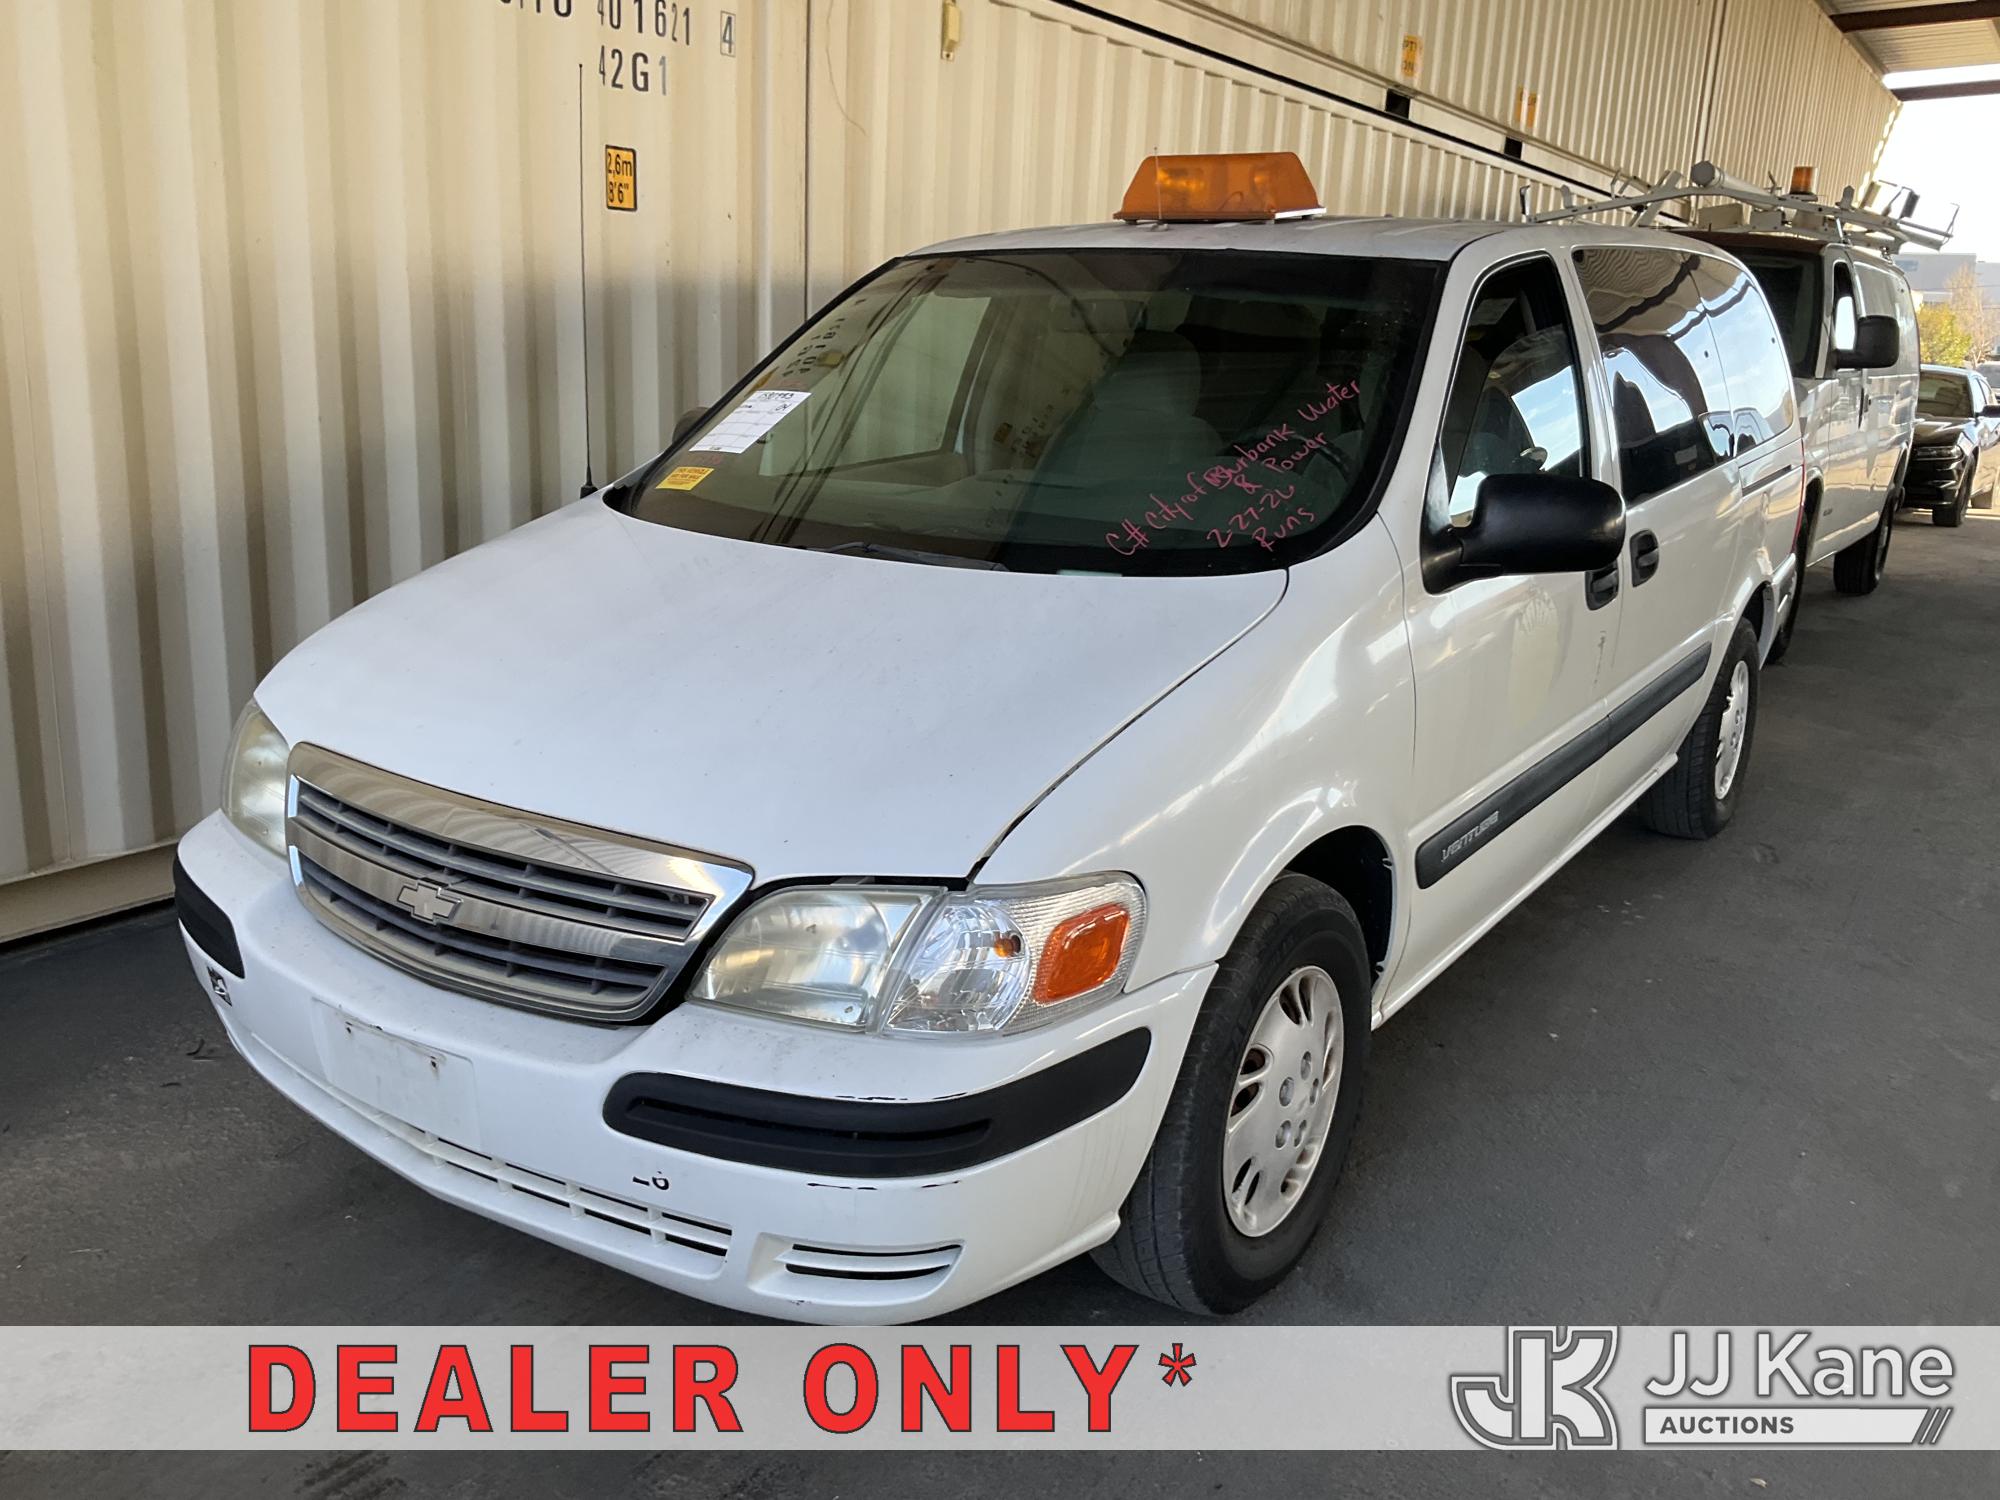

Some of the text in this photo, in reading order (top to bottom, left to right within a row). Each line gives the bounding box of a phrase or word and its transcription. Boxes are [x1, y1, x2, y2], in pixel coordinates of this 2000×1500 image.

[721, 16, 735, 54] 4
[598, 45, 668, 96] 42G1
[1145, 493, 1194, 530] City
[1180, 471, 1209, 504] of
[1297, 379, 1361, 422] Water
[1261, 431, 1328, 475] Power
[1252, 506, 1316, 553] Runs
